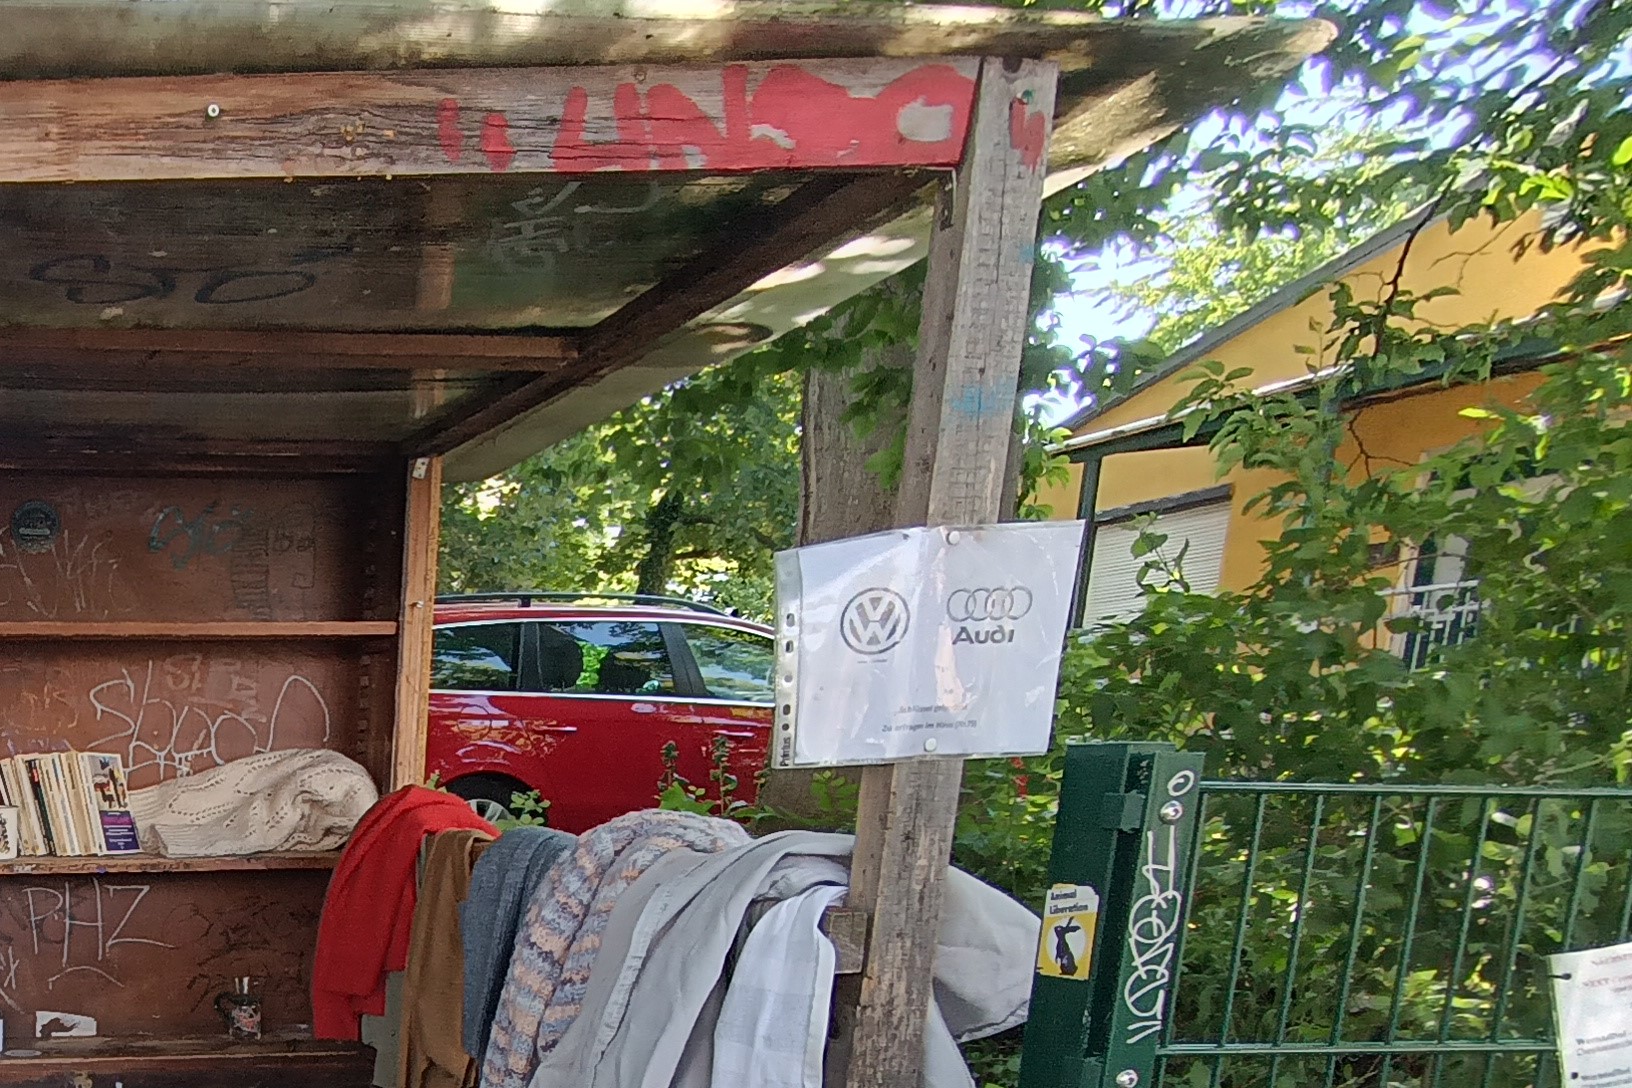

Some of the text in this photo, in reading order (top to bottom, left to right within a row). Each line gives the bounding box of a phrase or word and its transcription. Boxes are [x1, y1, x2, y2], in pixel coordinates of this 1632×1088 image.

[952, 625, 1014, 645] Audi
[1050, 889, 1078, 901] Animal
[1049, 902, 1089, 915] Liberation
